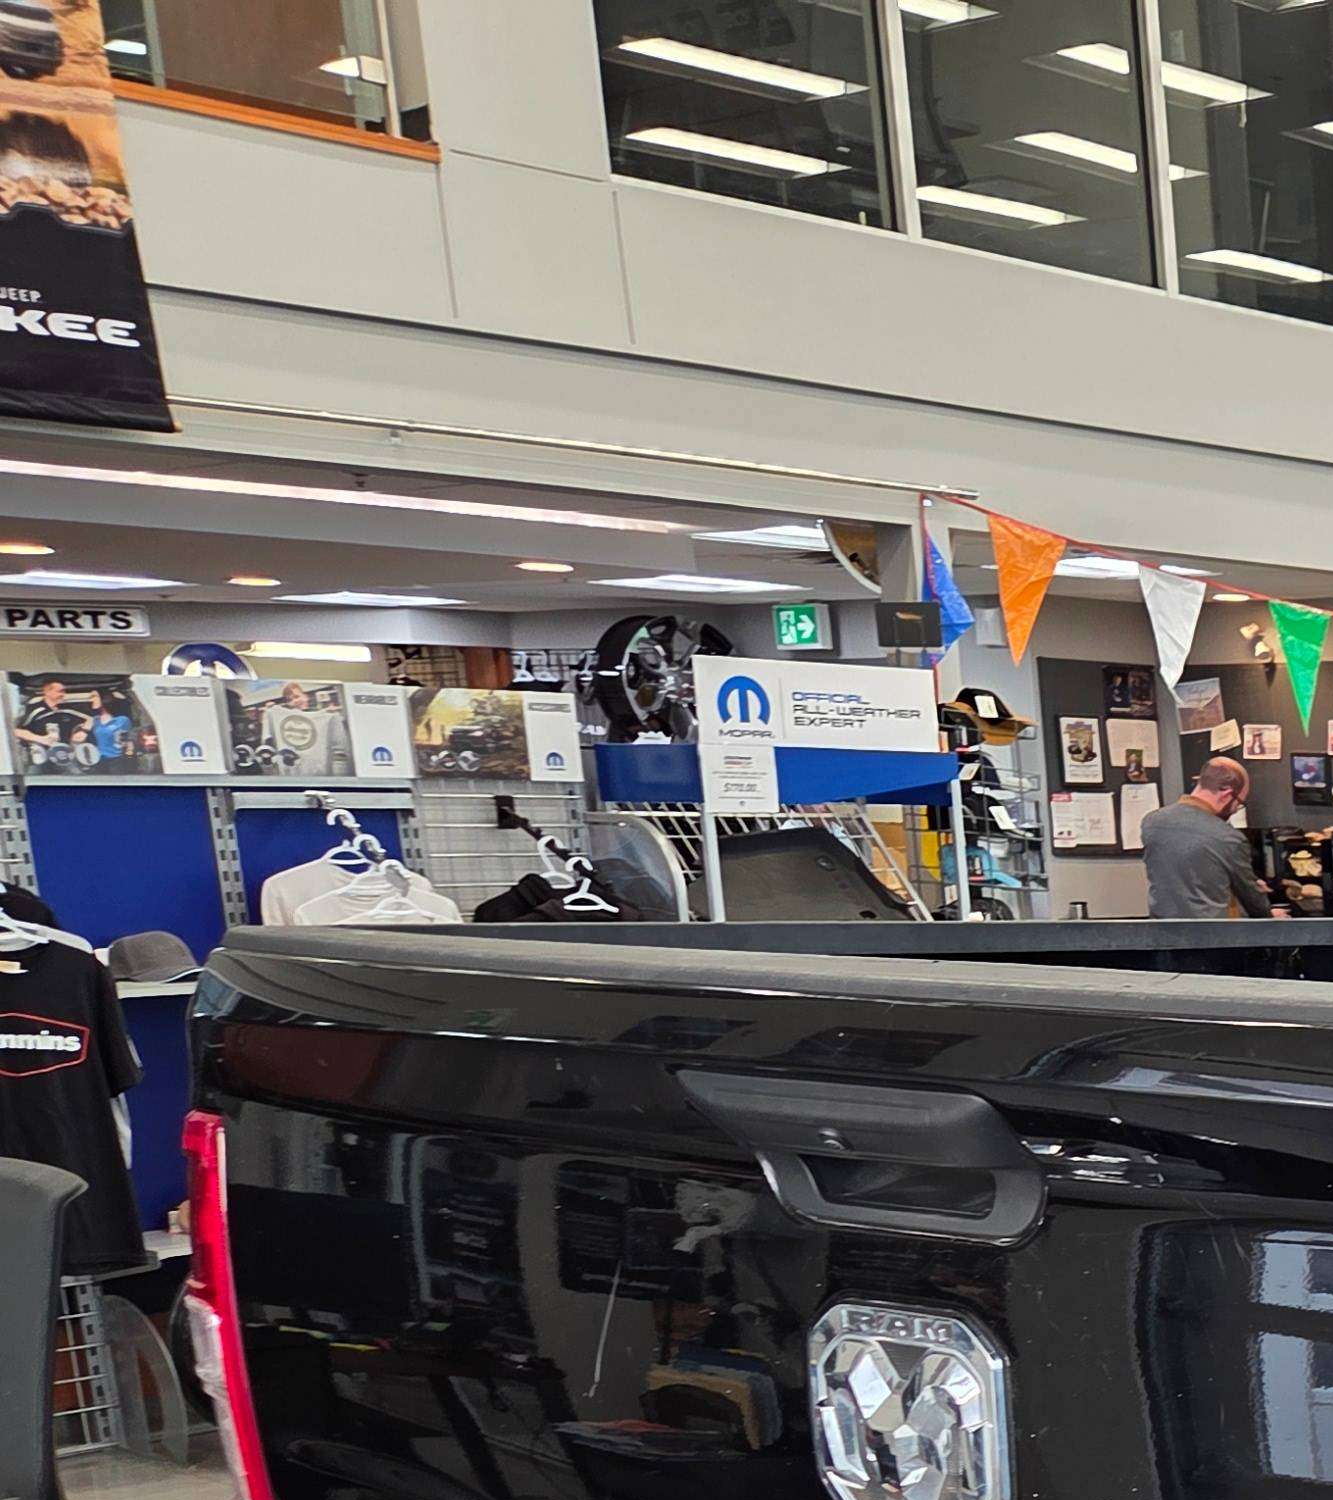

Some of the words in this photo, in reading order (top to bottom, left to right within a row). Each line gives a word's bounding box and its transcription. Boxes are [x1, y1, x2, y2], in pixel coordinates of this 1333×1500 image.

[5, 608, 133, 630] PARTS
[791, 690, 871, 705] OFFICIAL
[793, 704, 921, 719] ALL-WEATHER
[794, 716, 867, 729] EXPERT
[718, 728, 774, 739] MOPAR
[838, 1307, 955, 1342] RAM
